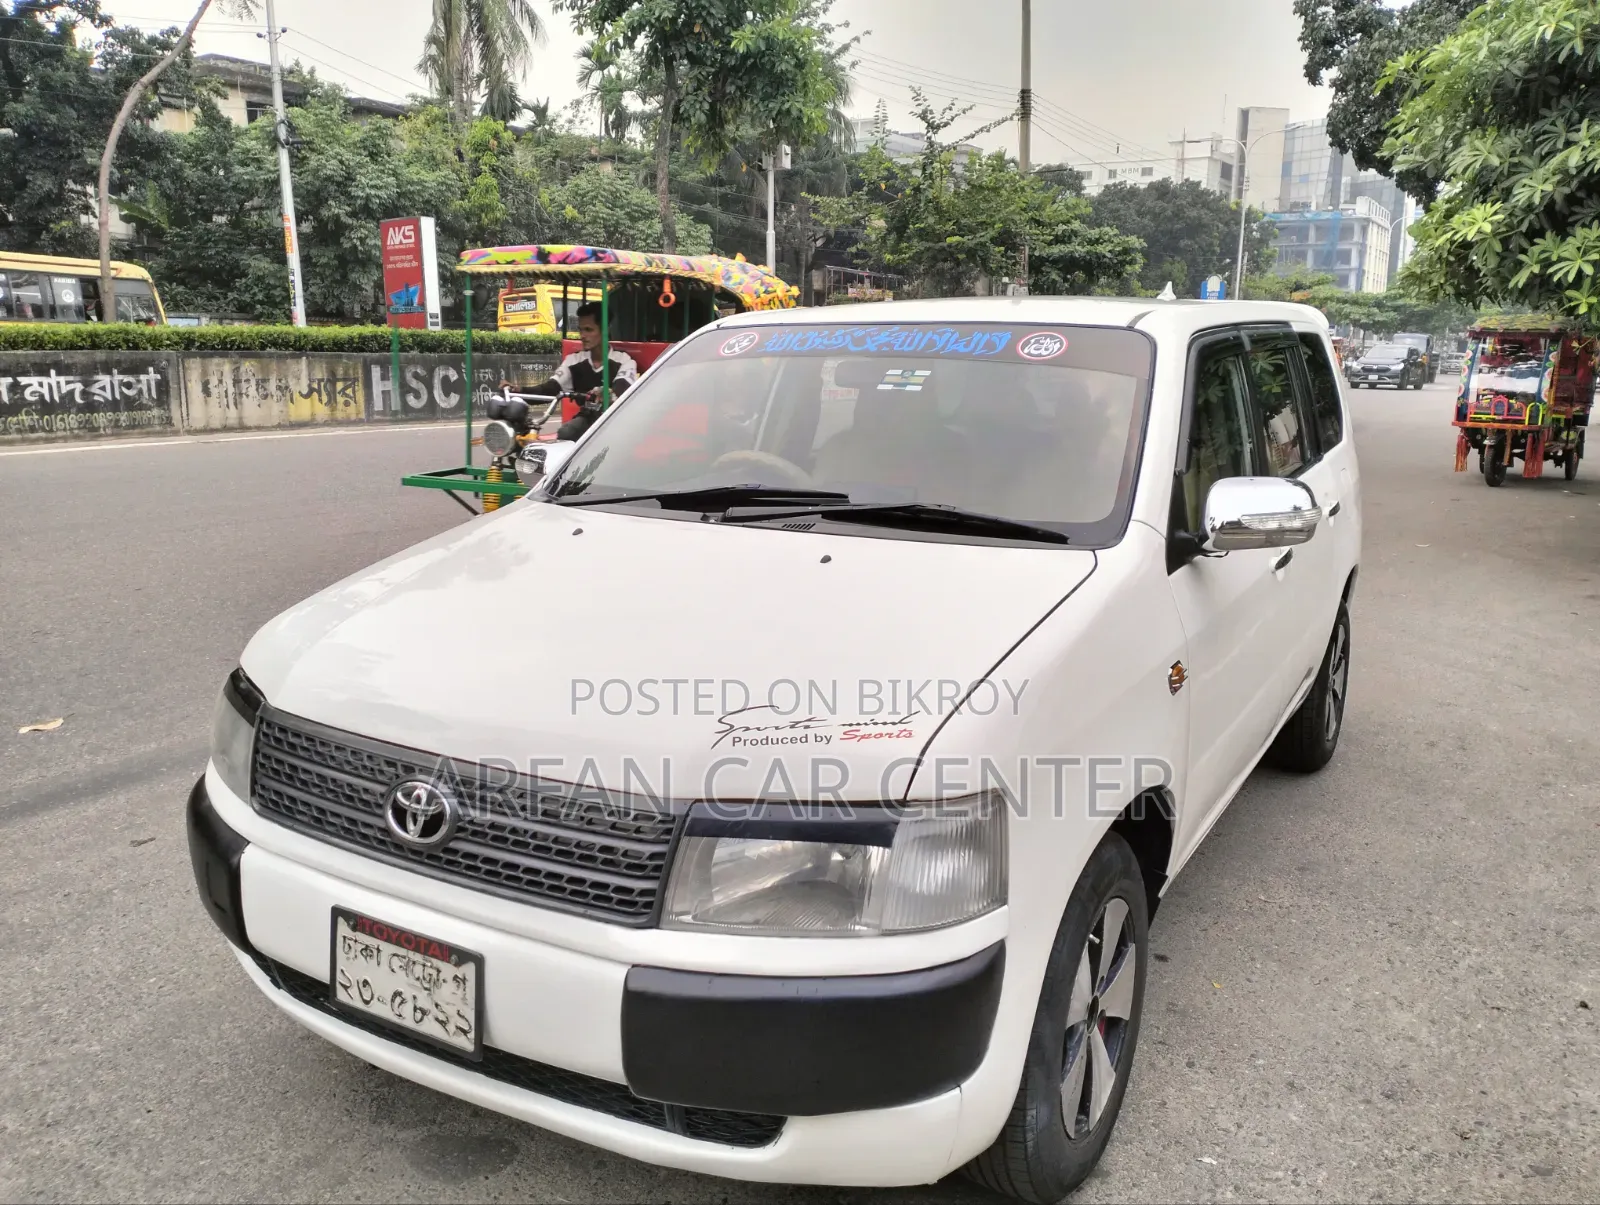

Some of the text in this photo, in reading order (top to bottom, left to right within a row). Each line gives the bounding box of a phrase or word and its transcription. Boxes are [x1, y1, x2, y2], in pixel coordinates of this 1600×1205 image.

[386, 225, 415, 246] AKS
[371, 364, 460, 411] HSC
[732, 728, 915, 747] Produced by Sports
[342, 935, 383, 967] ঢাকা
[362, 921, 444, 961] TOYOTA
